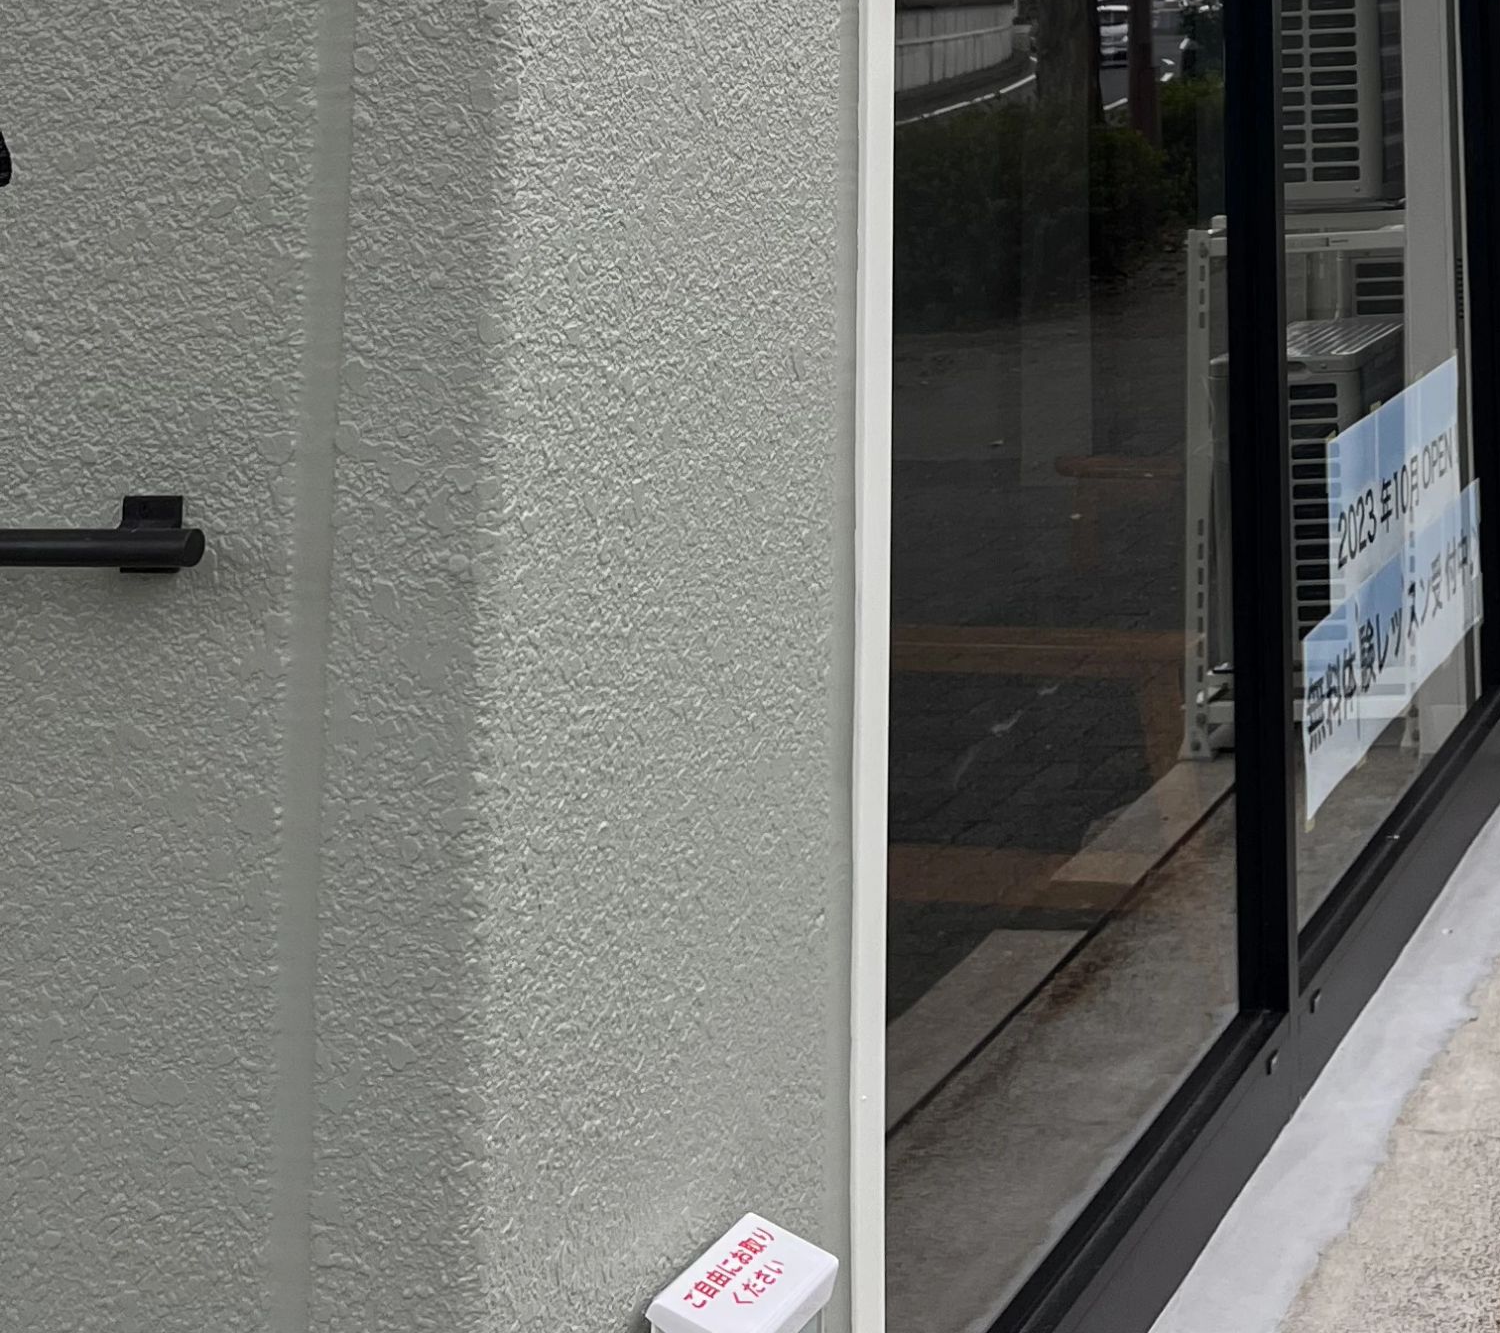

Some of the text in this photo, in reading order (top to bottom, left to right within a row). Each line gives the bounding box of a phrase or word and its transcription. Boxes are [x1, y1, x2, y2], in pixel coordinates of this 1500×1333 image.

[683, 1226, 775, 1309] ご自由にお取り
[732, 1259, 784, 1305] ください
